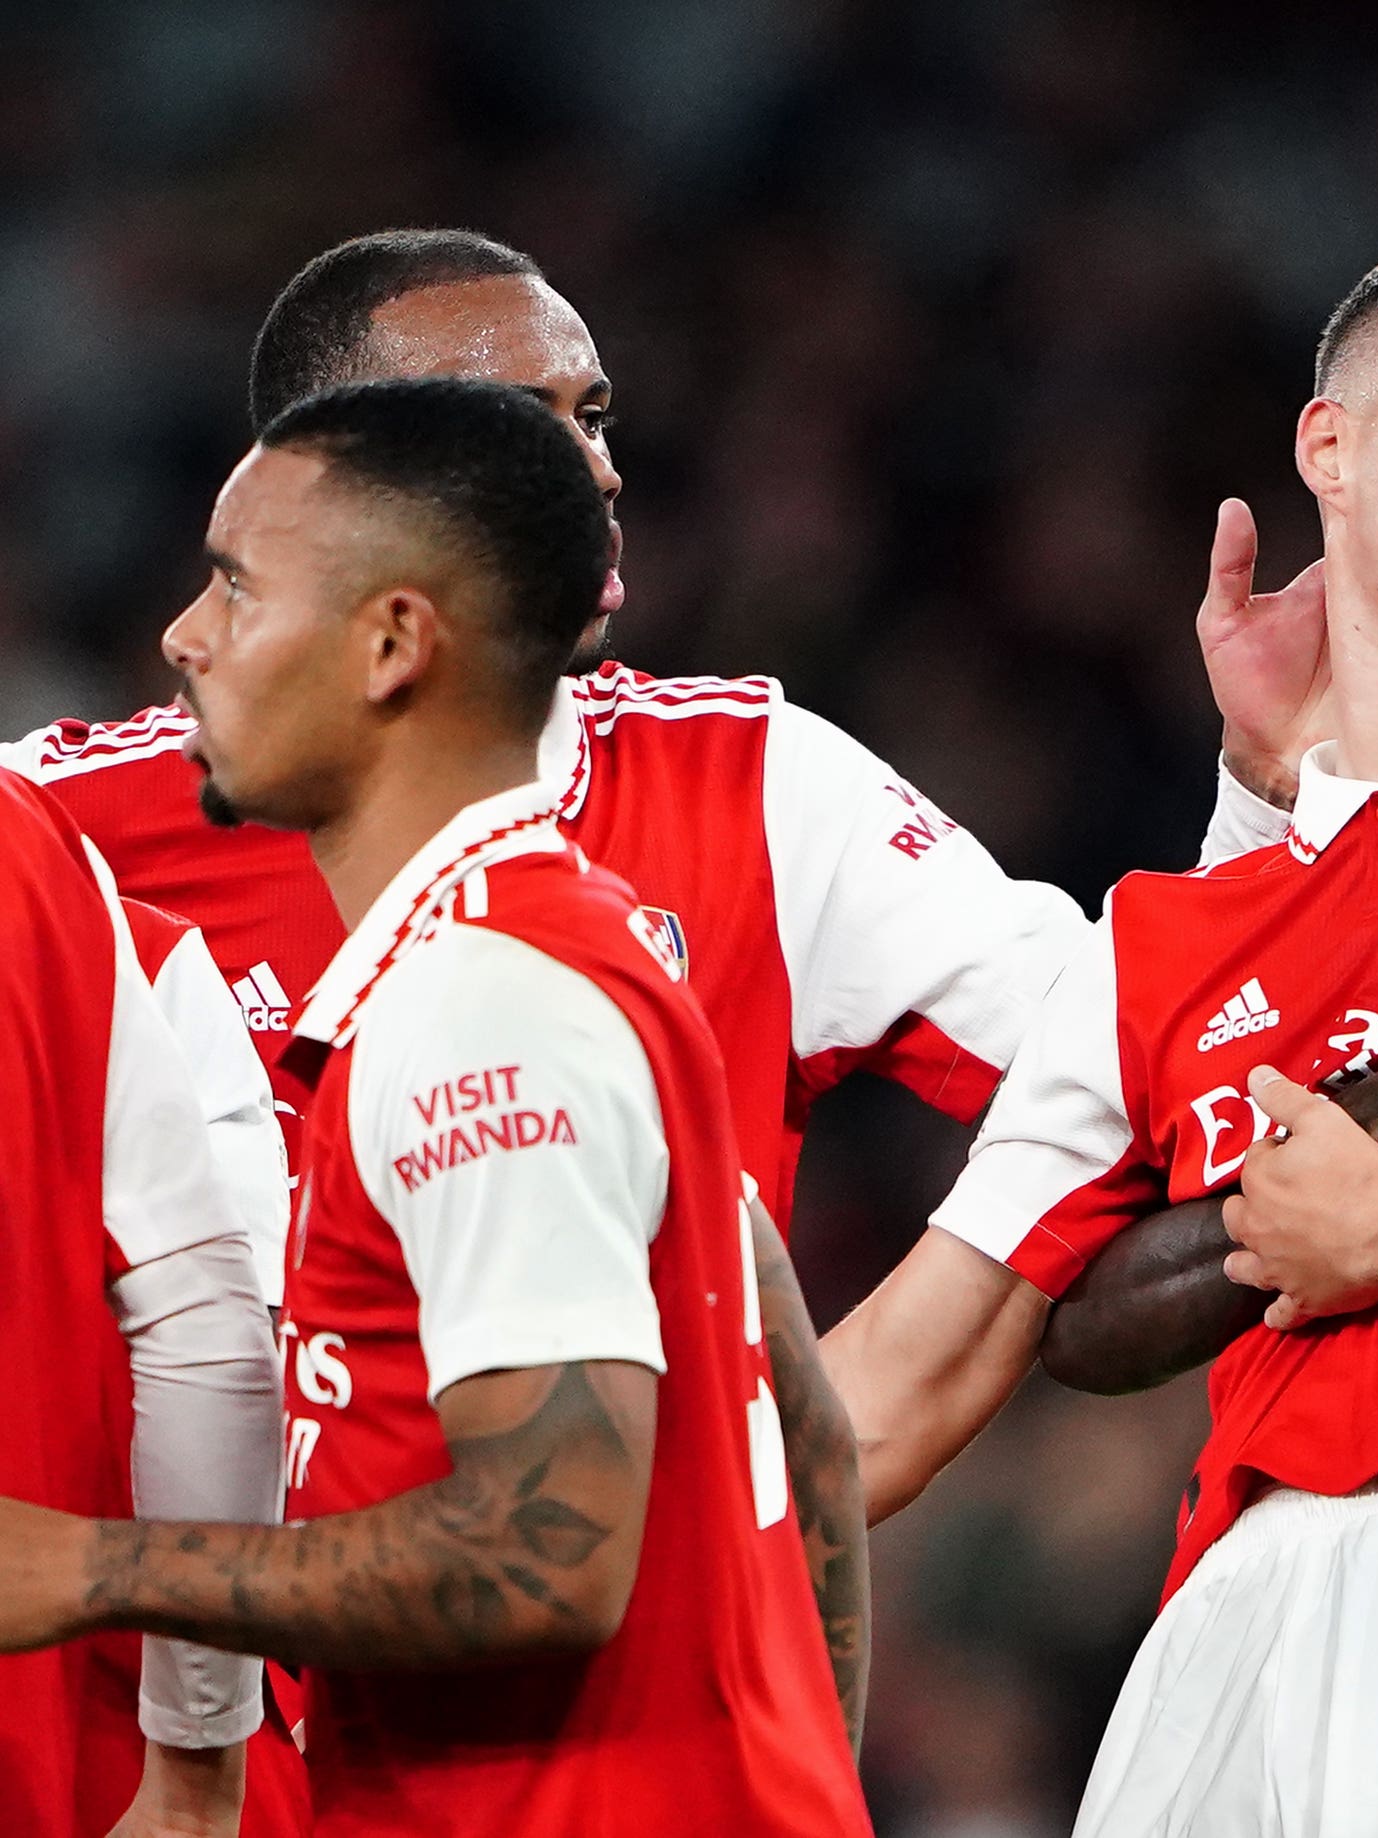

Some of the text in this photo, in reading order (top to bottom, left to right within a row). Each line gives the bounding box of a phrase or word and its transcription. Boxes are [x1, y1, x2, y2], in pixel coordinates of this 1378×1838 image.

[1197, 1009, 1280, 1052] adidas
[413, 1066, 520, 1126] VISIT
[393, 1109, 577, 1194] RWANDA
